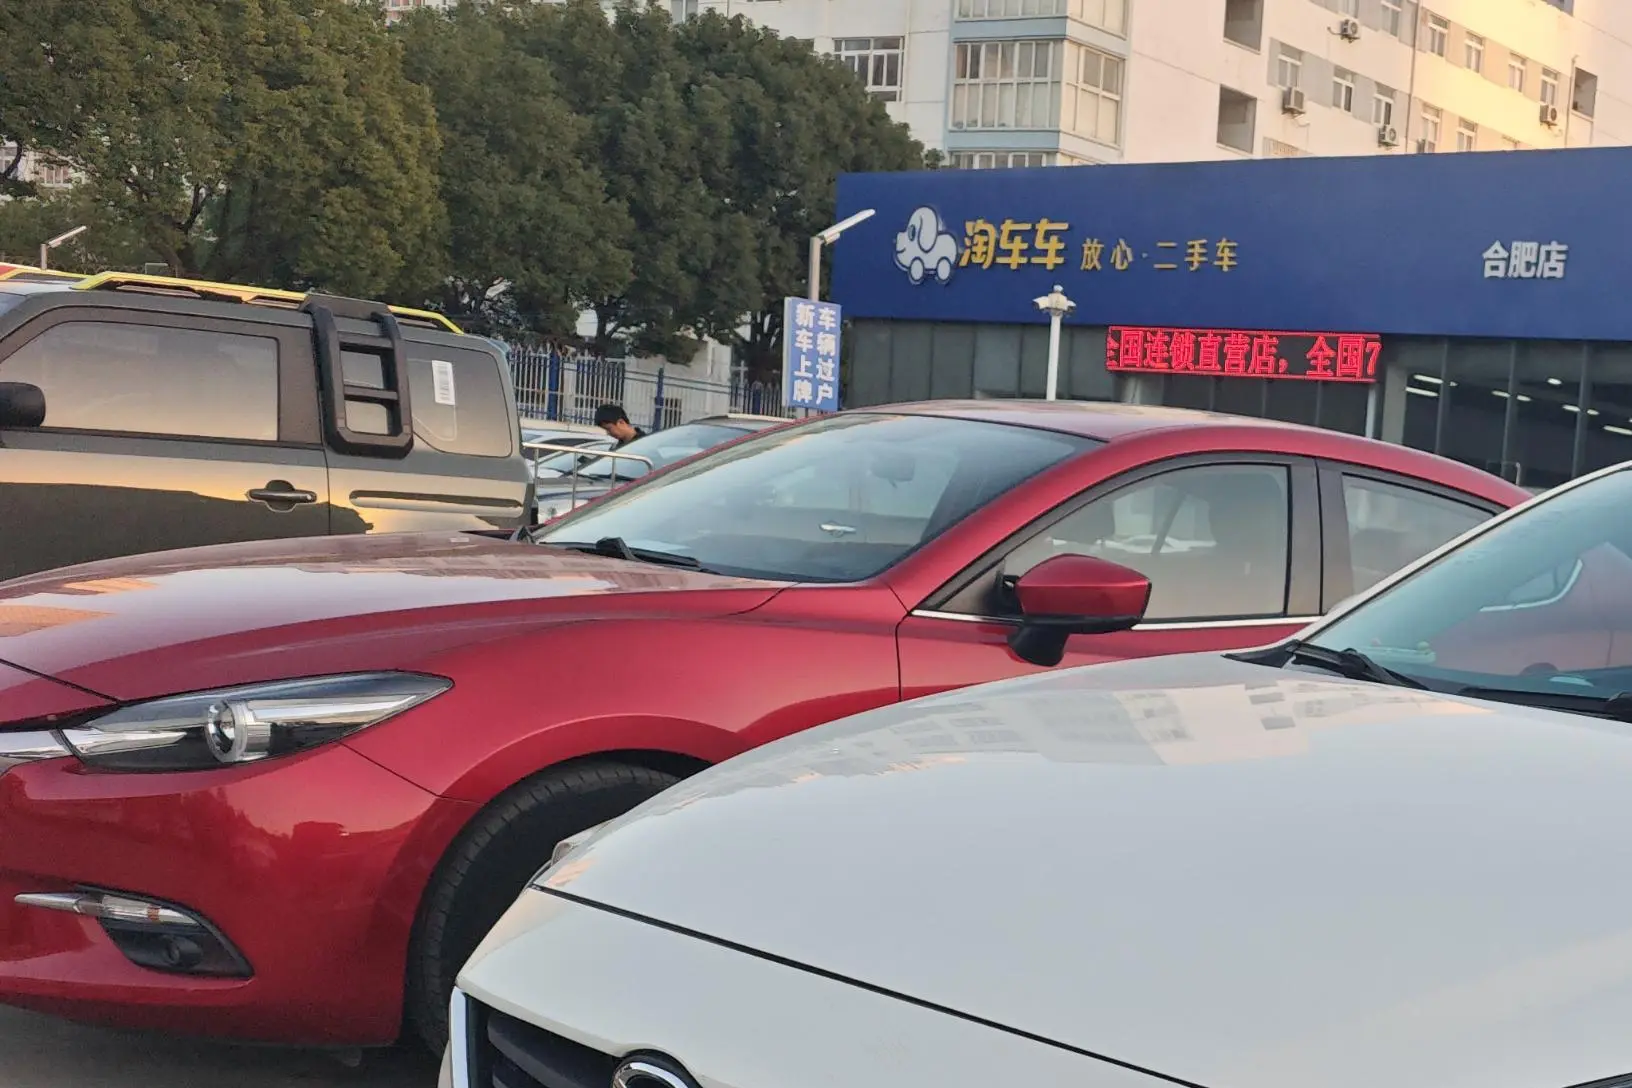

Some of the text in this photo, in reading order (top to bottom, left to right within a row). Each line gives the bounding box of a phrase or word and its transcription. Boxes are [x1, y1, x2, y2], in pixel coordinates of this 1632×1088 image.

[959, 218, 1069, 270] 淘车车
[1482, 240, 1568, 278] 合肥店
[816, 307, 837, 404] 车辆过户
